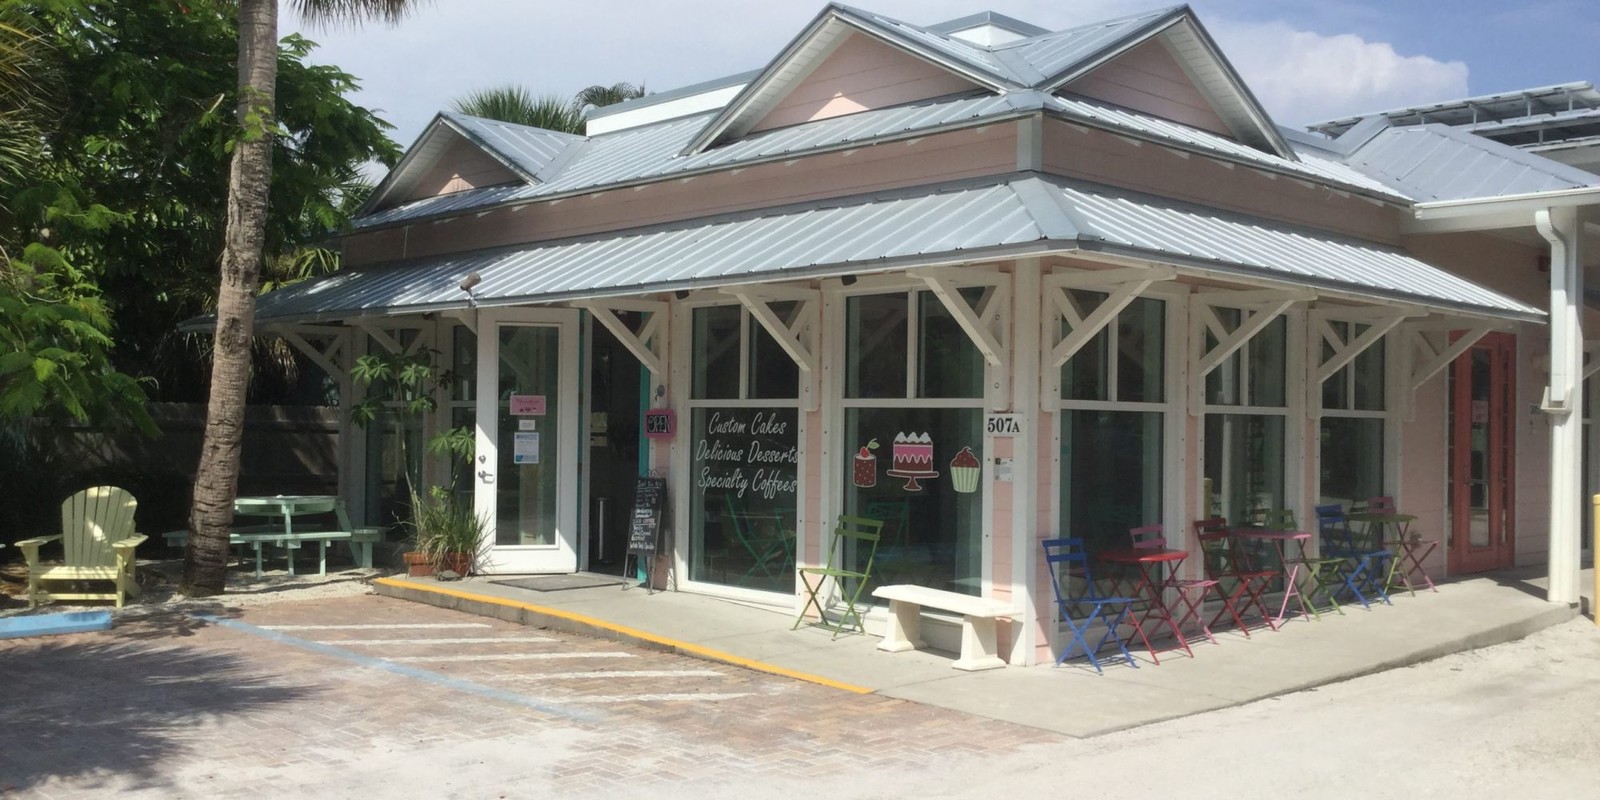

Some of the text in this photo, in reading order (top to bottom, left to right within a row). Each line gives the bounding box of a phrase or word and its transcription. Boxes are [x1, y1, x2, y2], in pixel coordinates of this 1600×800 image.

[647, 415, 671, 433] OPEN
[708, 411, 787, 435] Custom Cakes
[987, 417, 1021, 433] 507A
[695, 439, 799, 463] Delicious Desserts
[697, 466, 798, 500] Specialty Coffees
